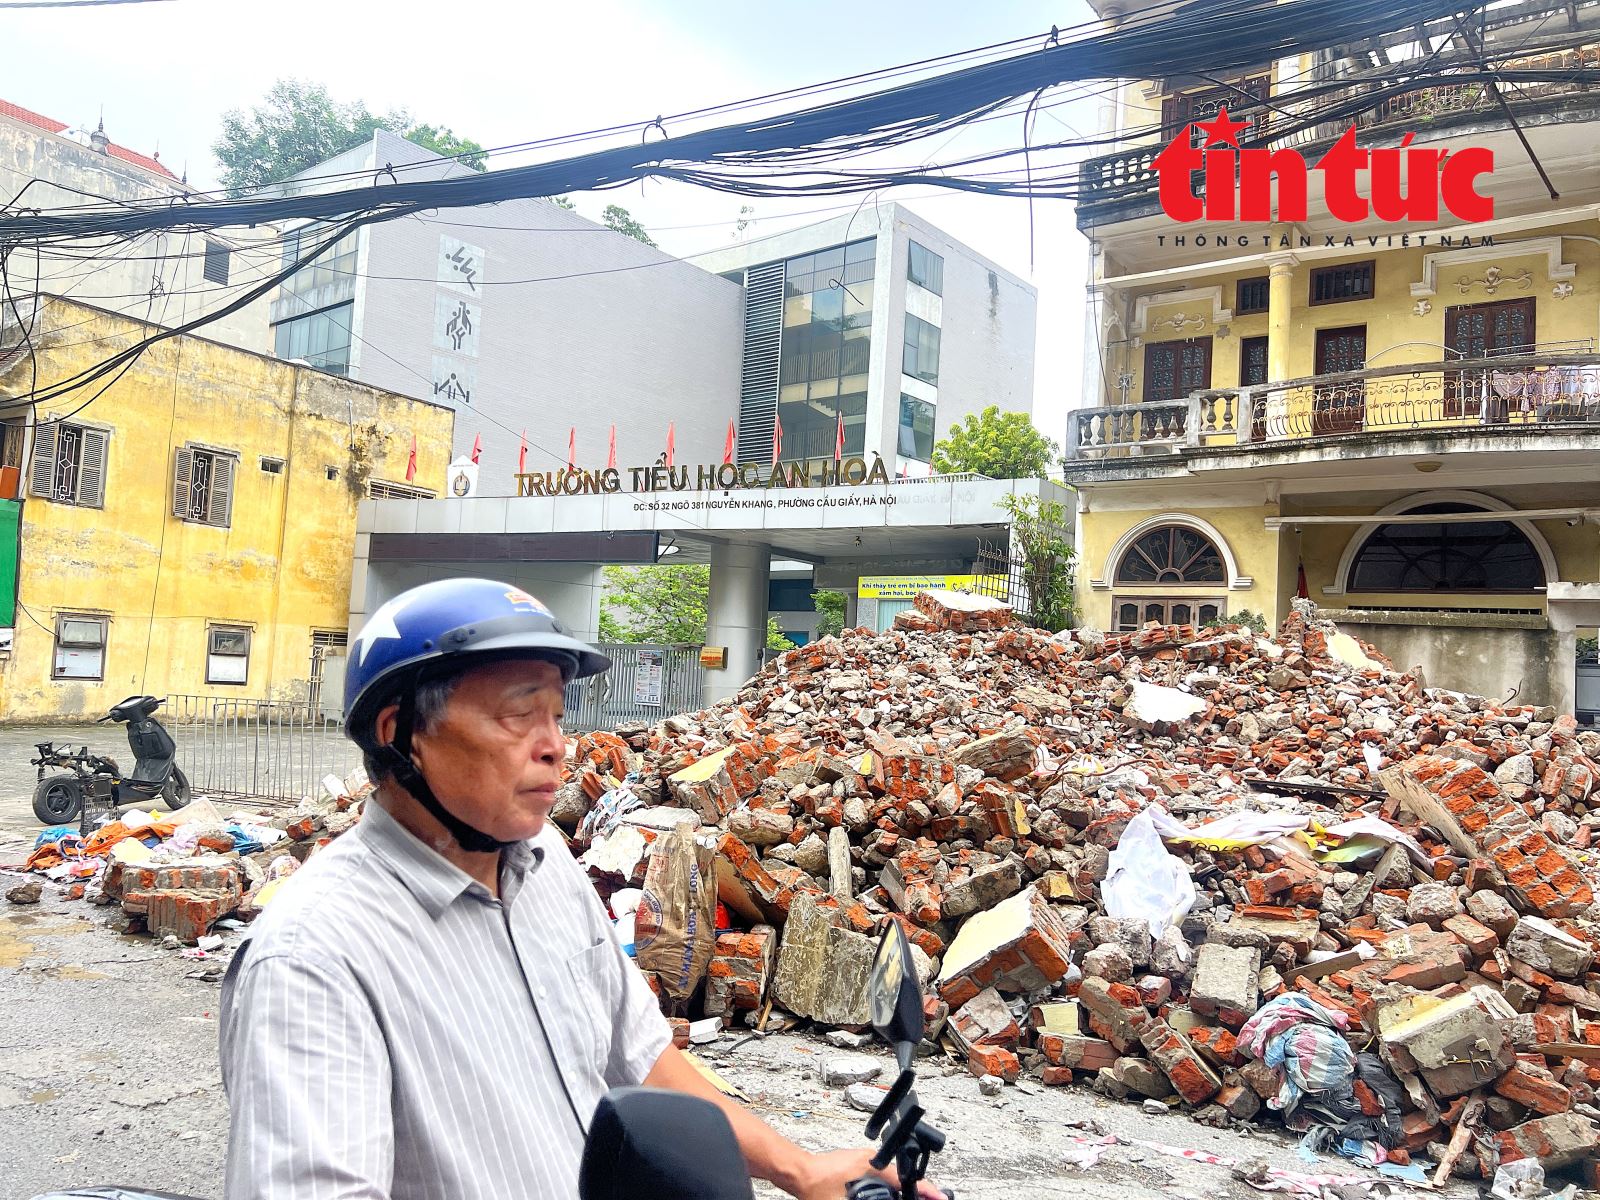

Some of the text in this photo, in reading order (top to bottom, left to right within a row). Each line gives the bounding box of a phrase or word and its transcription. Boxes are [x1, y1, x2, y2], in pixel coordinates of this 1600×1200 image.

[513, 451, 889, 497] TRƯỜNG TIỂU HỌC AN HOÀ
[648, 499, 660, 511] SỐ
[661, 502, 670, 511] 32
[671, 500, 690, 510] NGÕ
[691, 501, 704, 510] 381
[706, 497, 740, 509] NGUYỄN
[778, 496, 815, 508] PHƯỜNG
[863, 494, 877, 506] HÀ
[879, 493, 897, 508] NỘI
